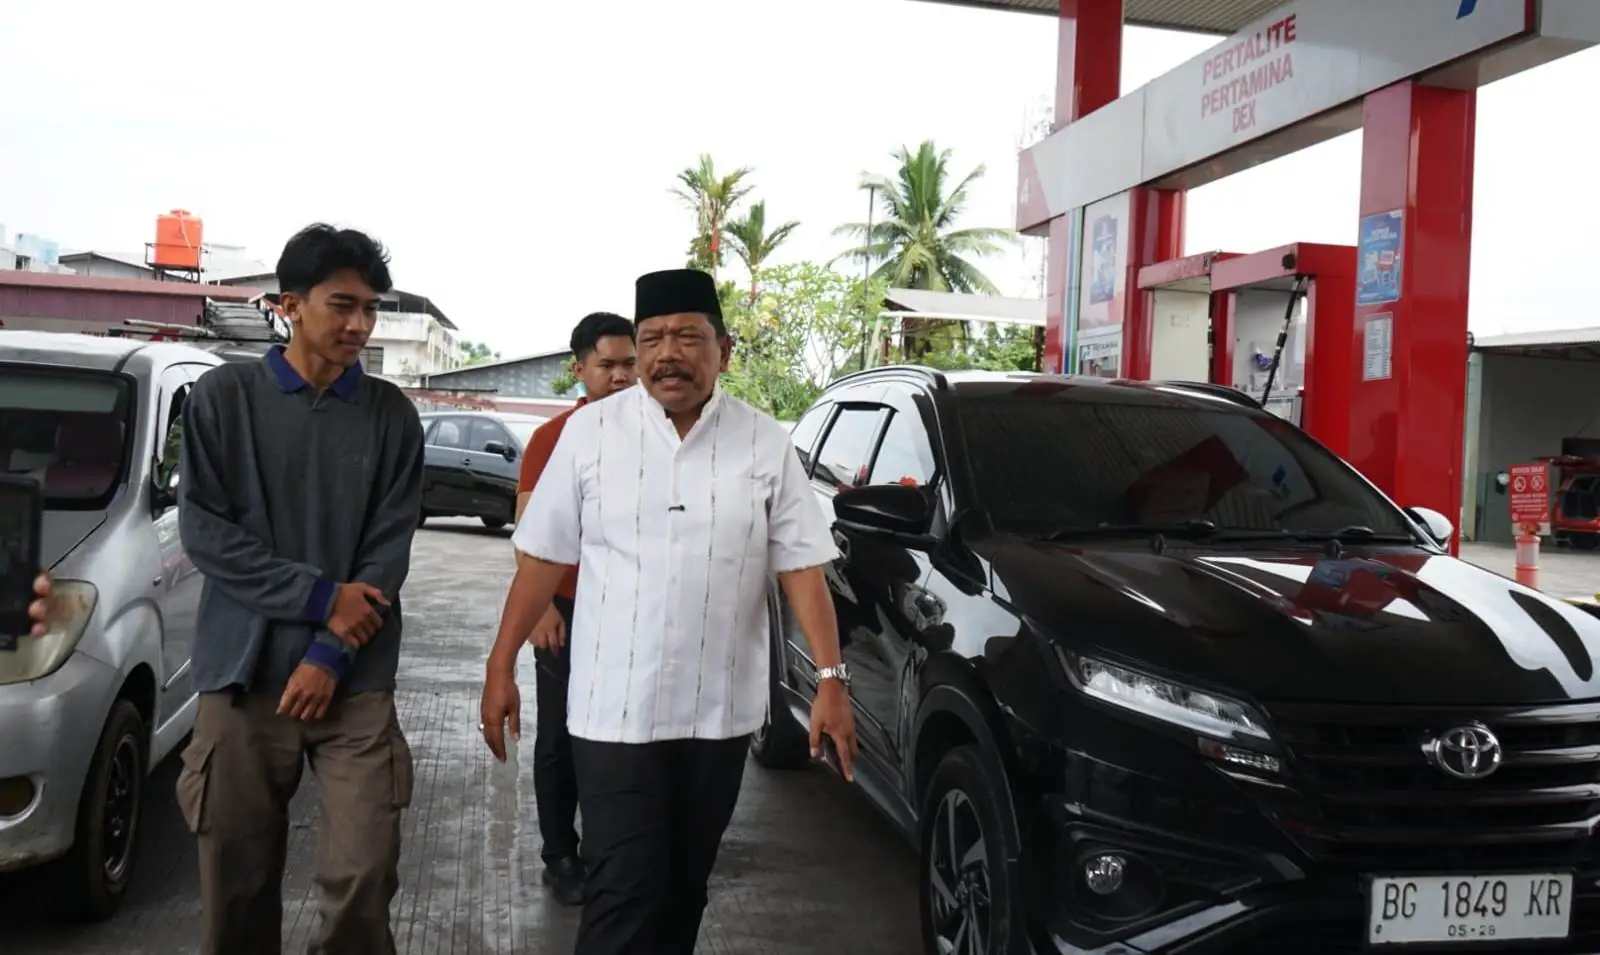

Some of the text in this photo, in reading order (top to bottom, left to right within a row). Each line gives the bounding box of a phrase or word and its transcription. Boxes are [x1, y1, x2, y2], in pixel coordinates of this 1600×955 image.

[1203, 13, 1297, 87] PERTALITE
[1201, 53, 1293, 119] PERTAMINA
[1232, 99, 1256, 133] DEX
[1382, 879, 1563, 921] BG 1849 KR
